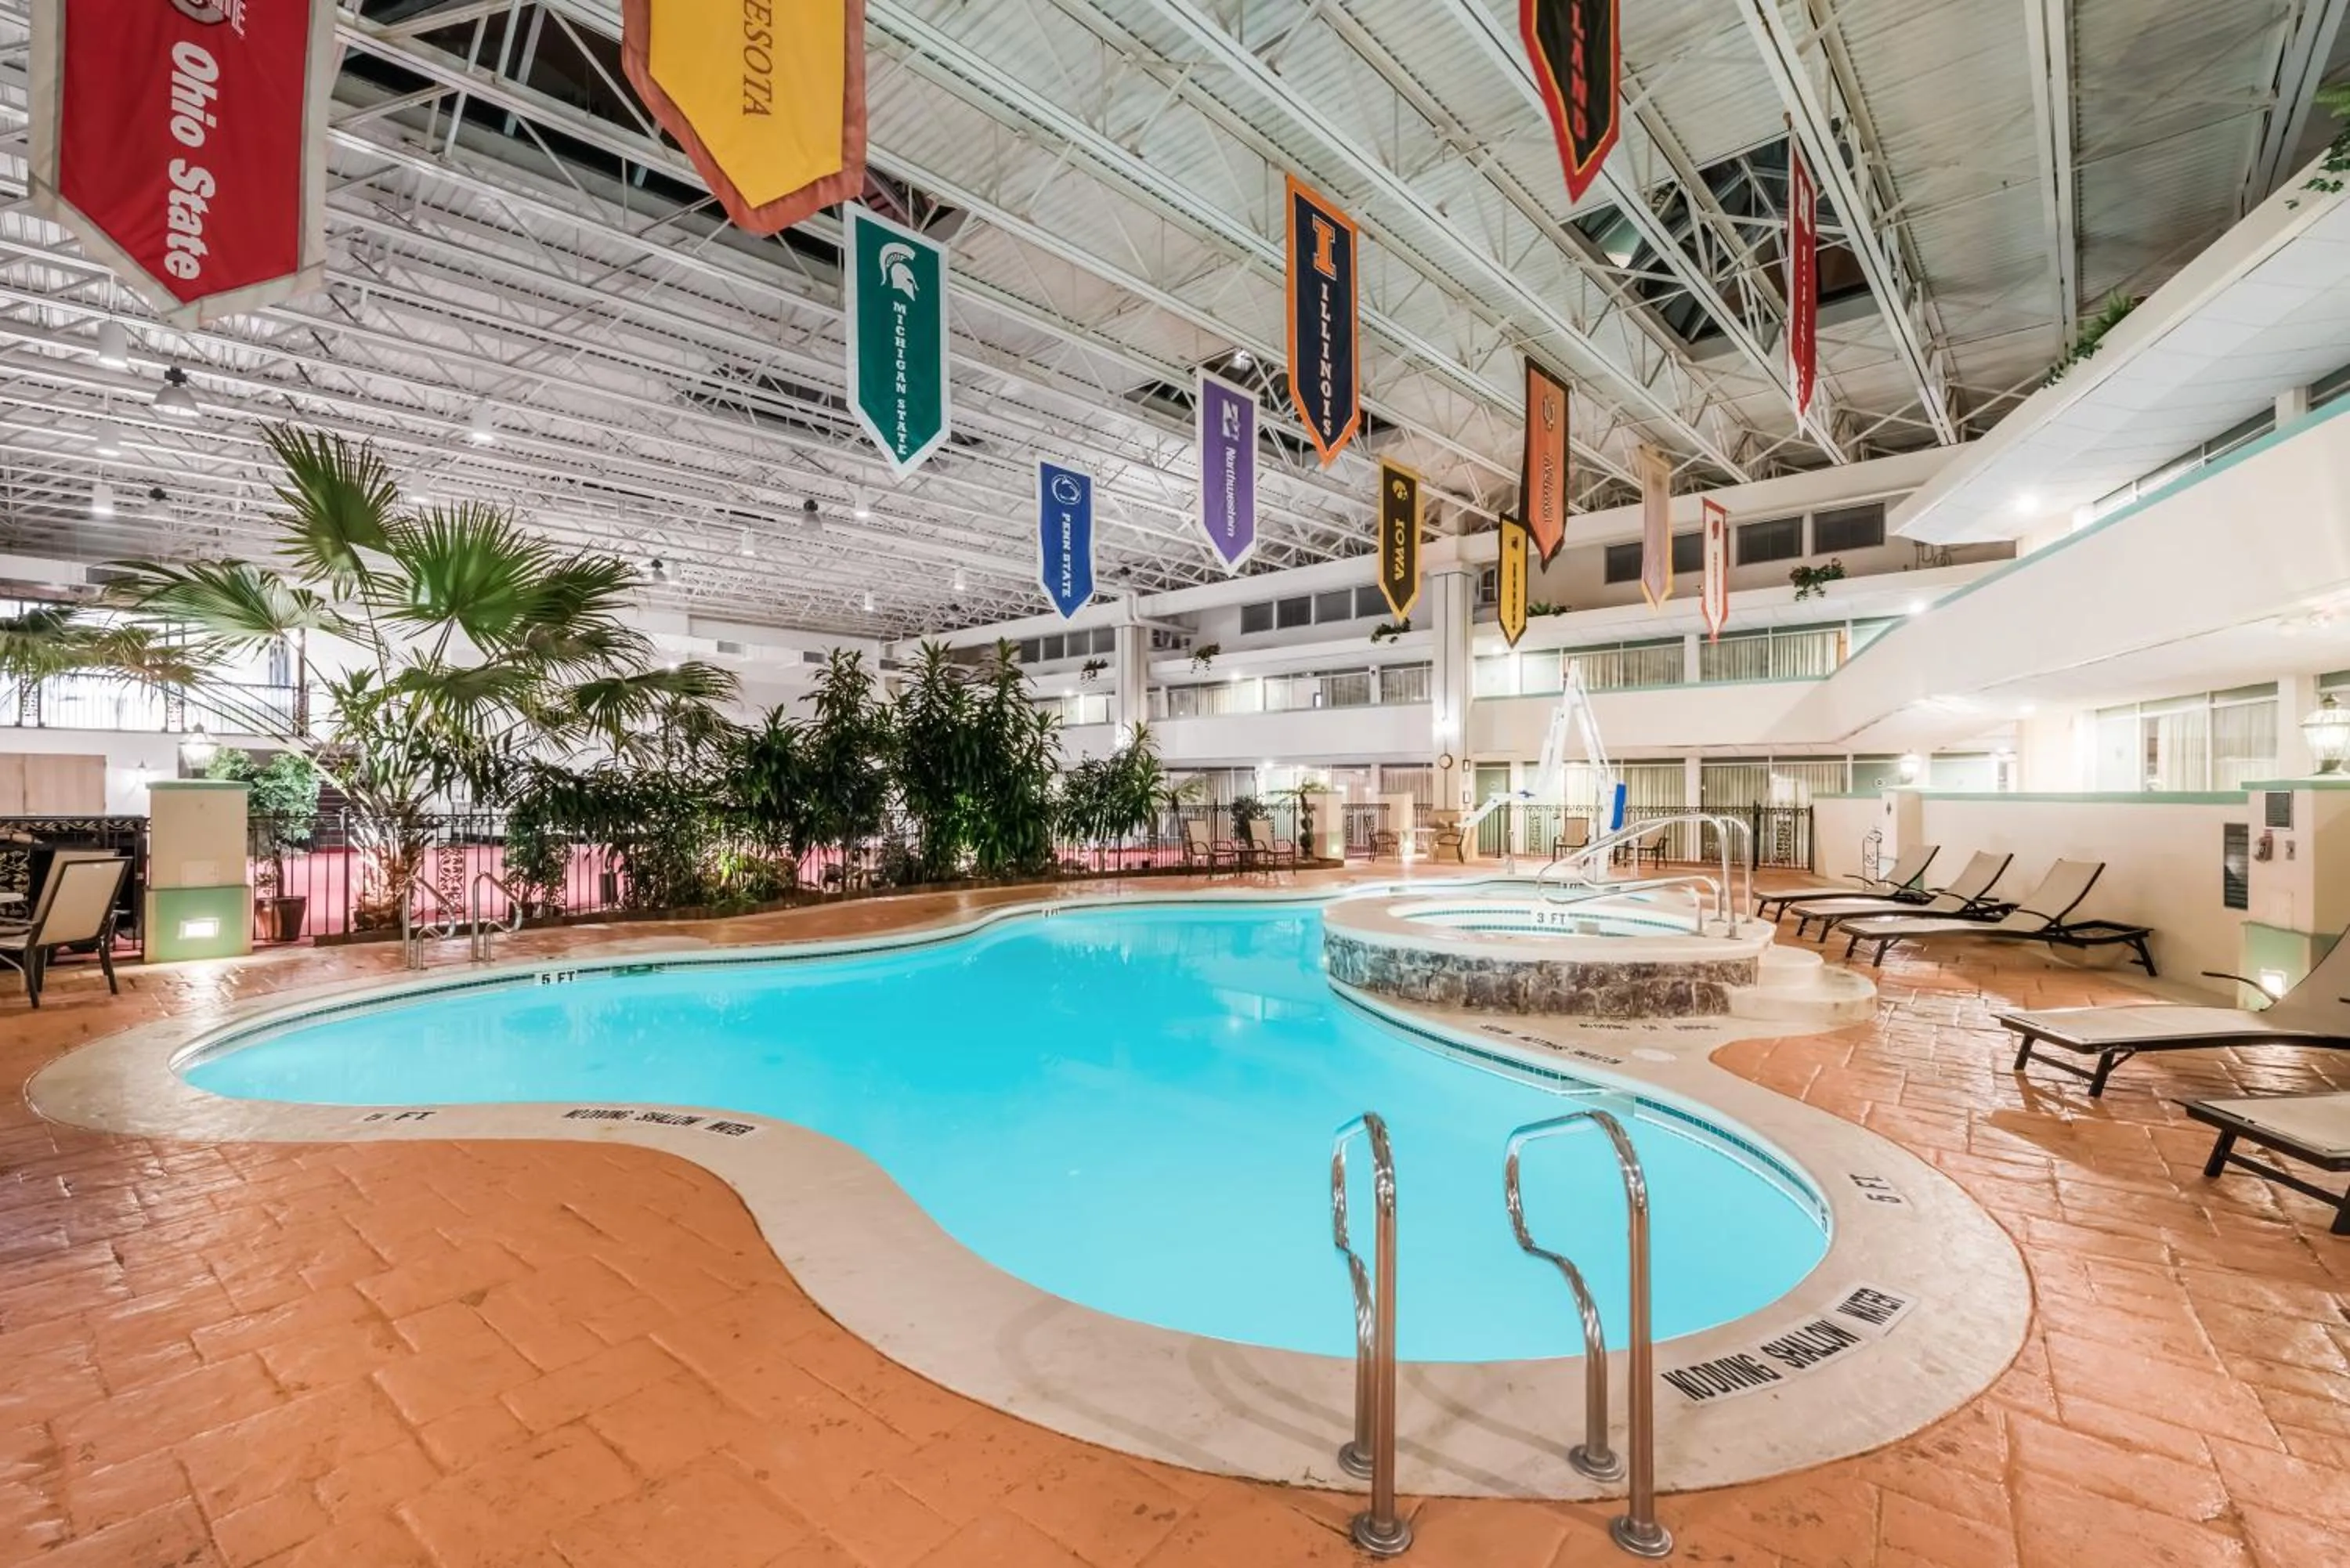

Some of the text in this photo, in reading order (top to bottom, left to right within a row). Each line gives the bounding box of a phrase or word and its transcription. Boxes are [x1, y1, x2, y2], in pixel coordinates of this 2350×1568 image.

[164, 42, 219, 280] Ohio State
[893, 301, 907, 455] MICHIGAN STATE
[1320, 282, 1332, 437] ILLINOIS
[1225, 446, 1237, 538] Northwestern
[1061, 511, 1071, 598] PENN STATE
[1394, 518, 1405, 580] IOWA
[1536, 912, 1566, 925] 3 FT
[557, 970, 576, 984] FT
[394, 1111, 437, 1121] FT
[1661, 1287, 1906, 1401] NO DIVING SHALLOW WATER
